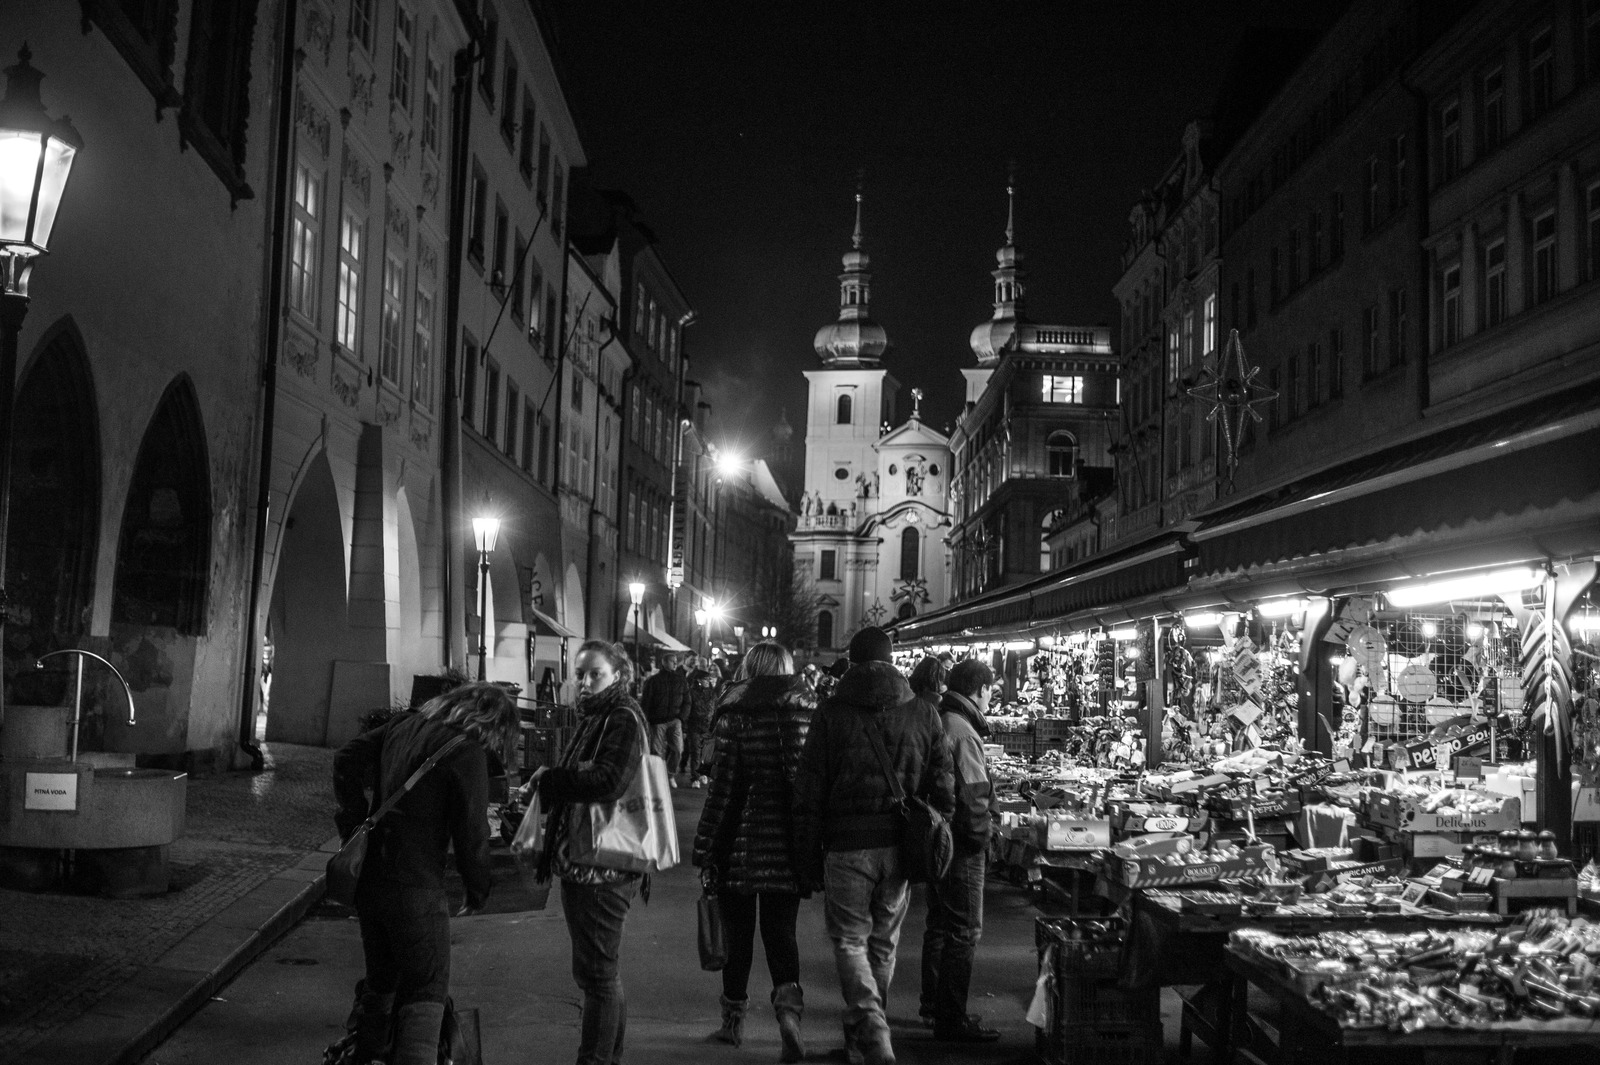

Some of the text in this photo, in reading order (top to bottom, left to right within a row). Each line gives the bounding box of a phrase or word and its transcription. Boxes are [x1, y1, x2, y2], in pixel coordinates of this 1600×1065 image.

[1412, 739, 1462, 768] pepno
[1466, 729, 1491, 745] gol
[1186, 866, 1217, 877] BOUQUET
